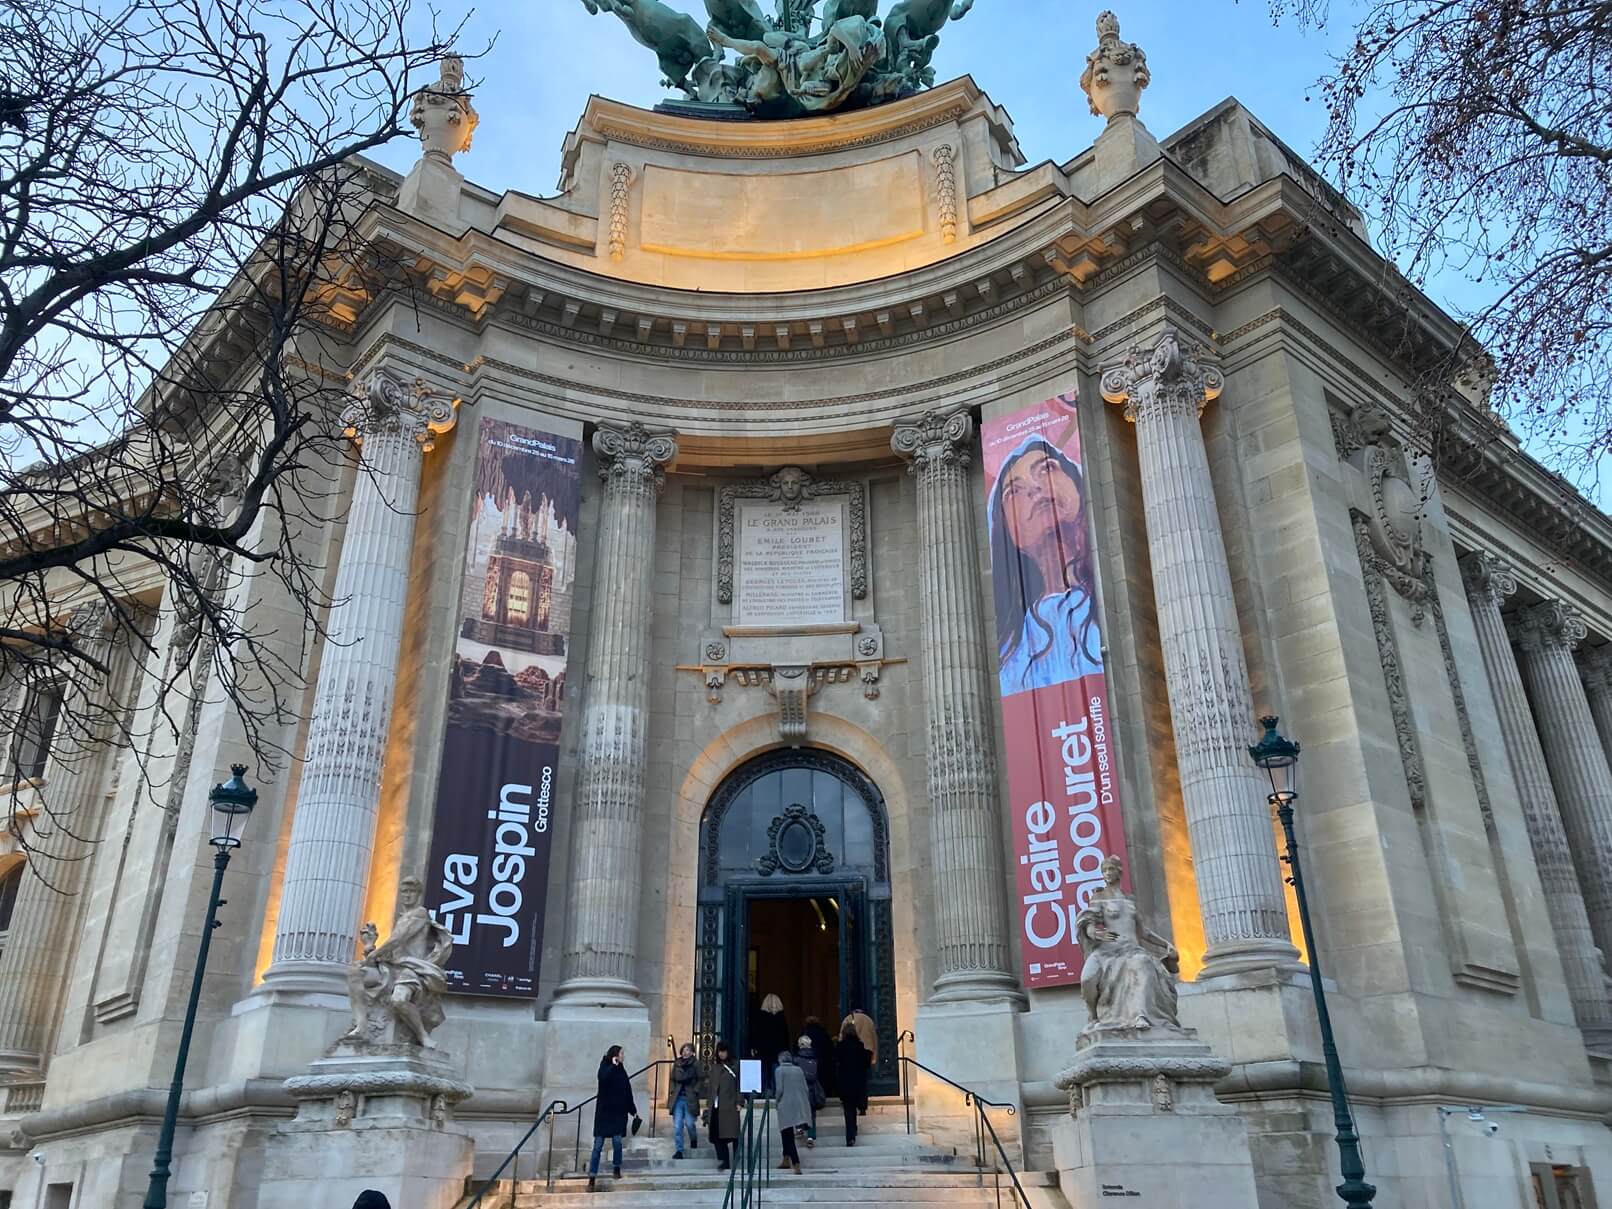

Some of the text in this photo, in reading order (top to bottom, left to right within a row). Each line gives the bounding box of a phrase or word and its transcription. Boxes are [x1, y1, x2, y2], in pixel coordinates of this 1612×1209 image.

[510, 434, 556, 452] GrandPalais
[1006, 413, 1049, 431] GrandPalais
[747, 516, 837, 528] LE GRAND PALAIS
[1088, 696, 1113, 804] D'un seul souffle
[534, 766, 553, 833] Grottesco
[428, 853, 479, 945] Eva
[476, 783, 536, 948] Jospin
[1020, 800, 1067, 949] Claire
